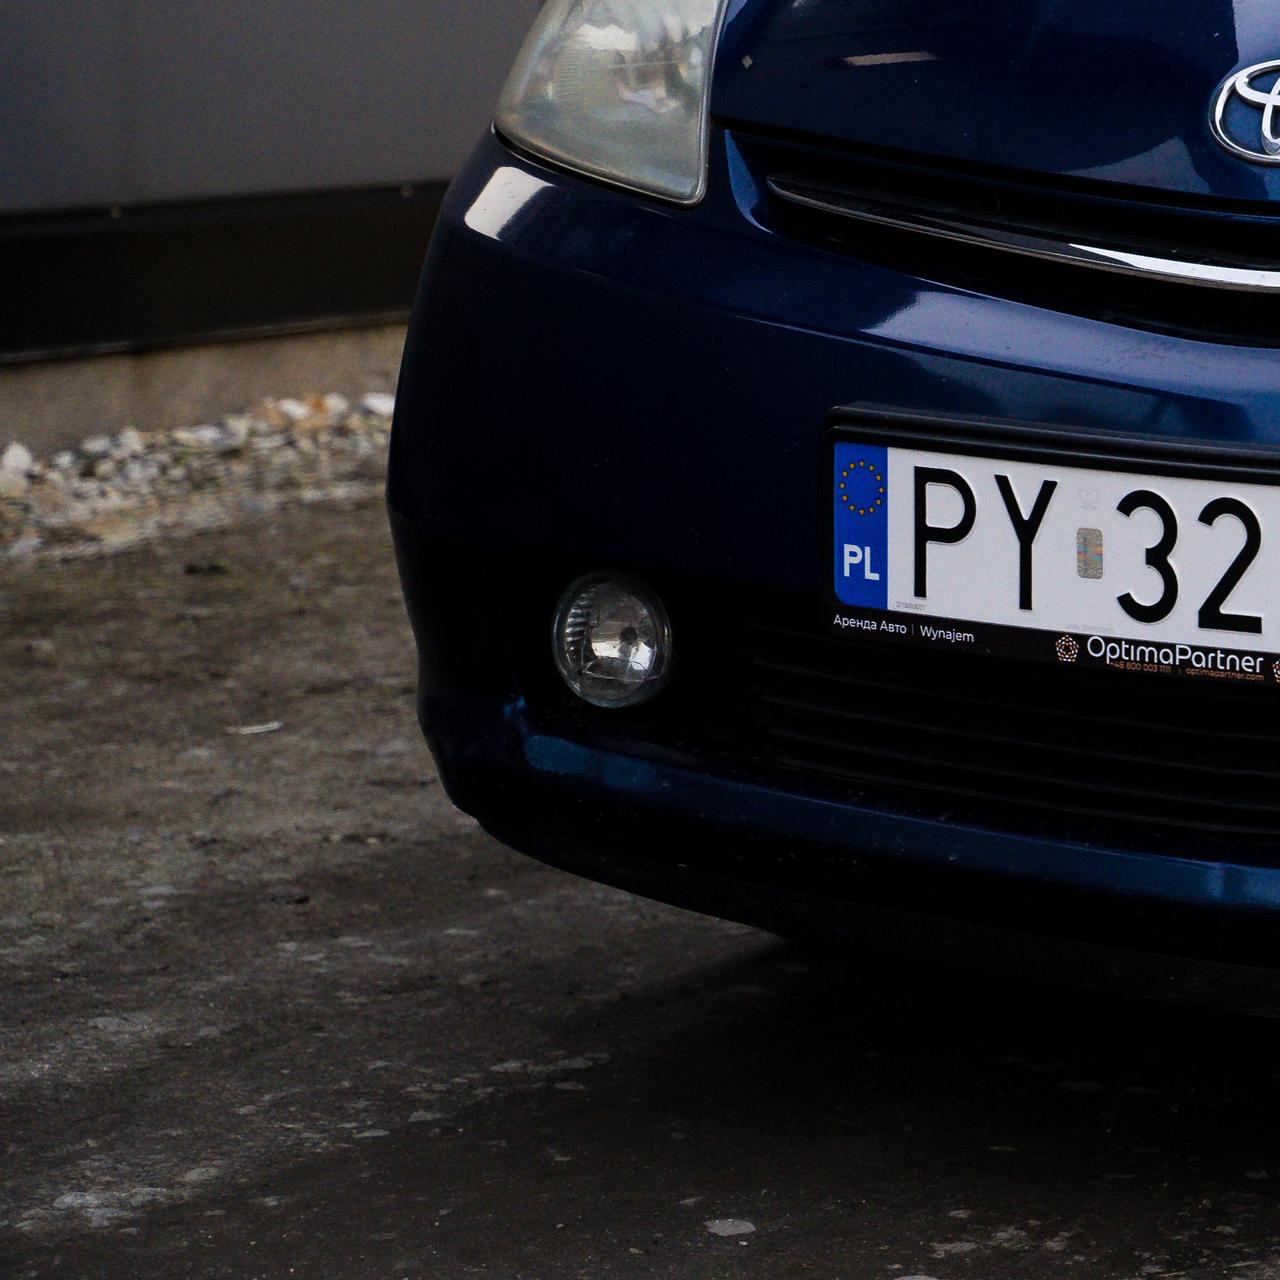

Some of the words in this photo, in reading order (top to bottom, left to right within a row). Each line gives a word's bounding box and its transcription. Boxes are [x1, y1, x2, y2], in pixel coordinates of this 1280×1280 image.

[914, 466, 1058, 610] PY
[843, 543, 880, 581] PL
[833, 614, 877, 631] Аренда
[880, 620, 907, 634] Авто
[920, 625, 975, 643] Wynajem
[1087, 635, 1265, 673] OptimaPartner
